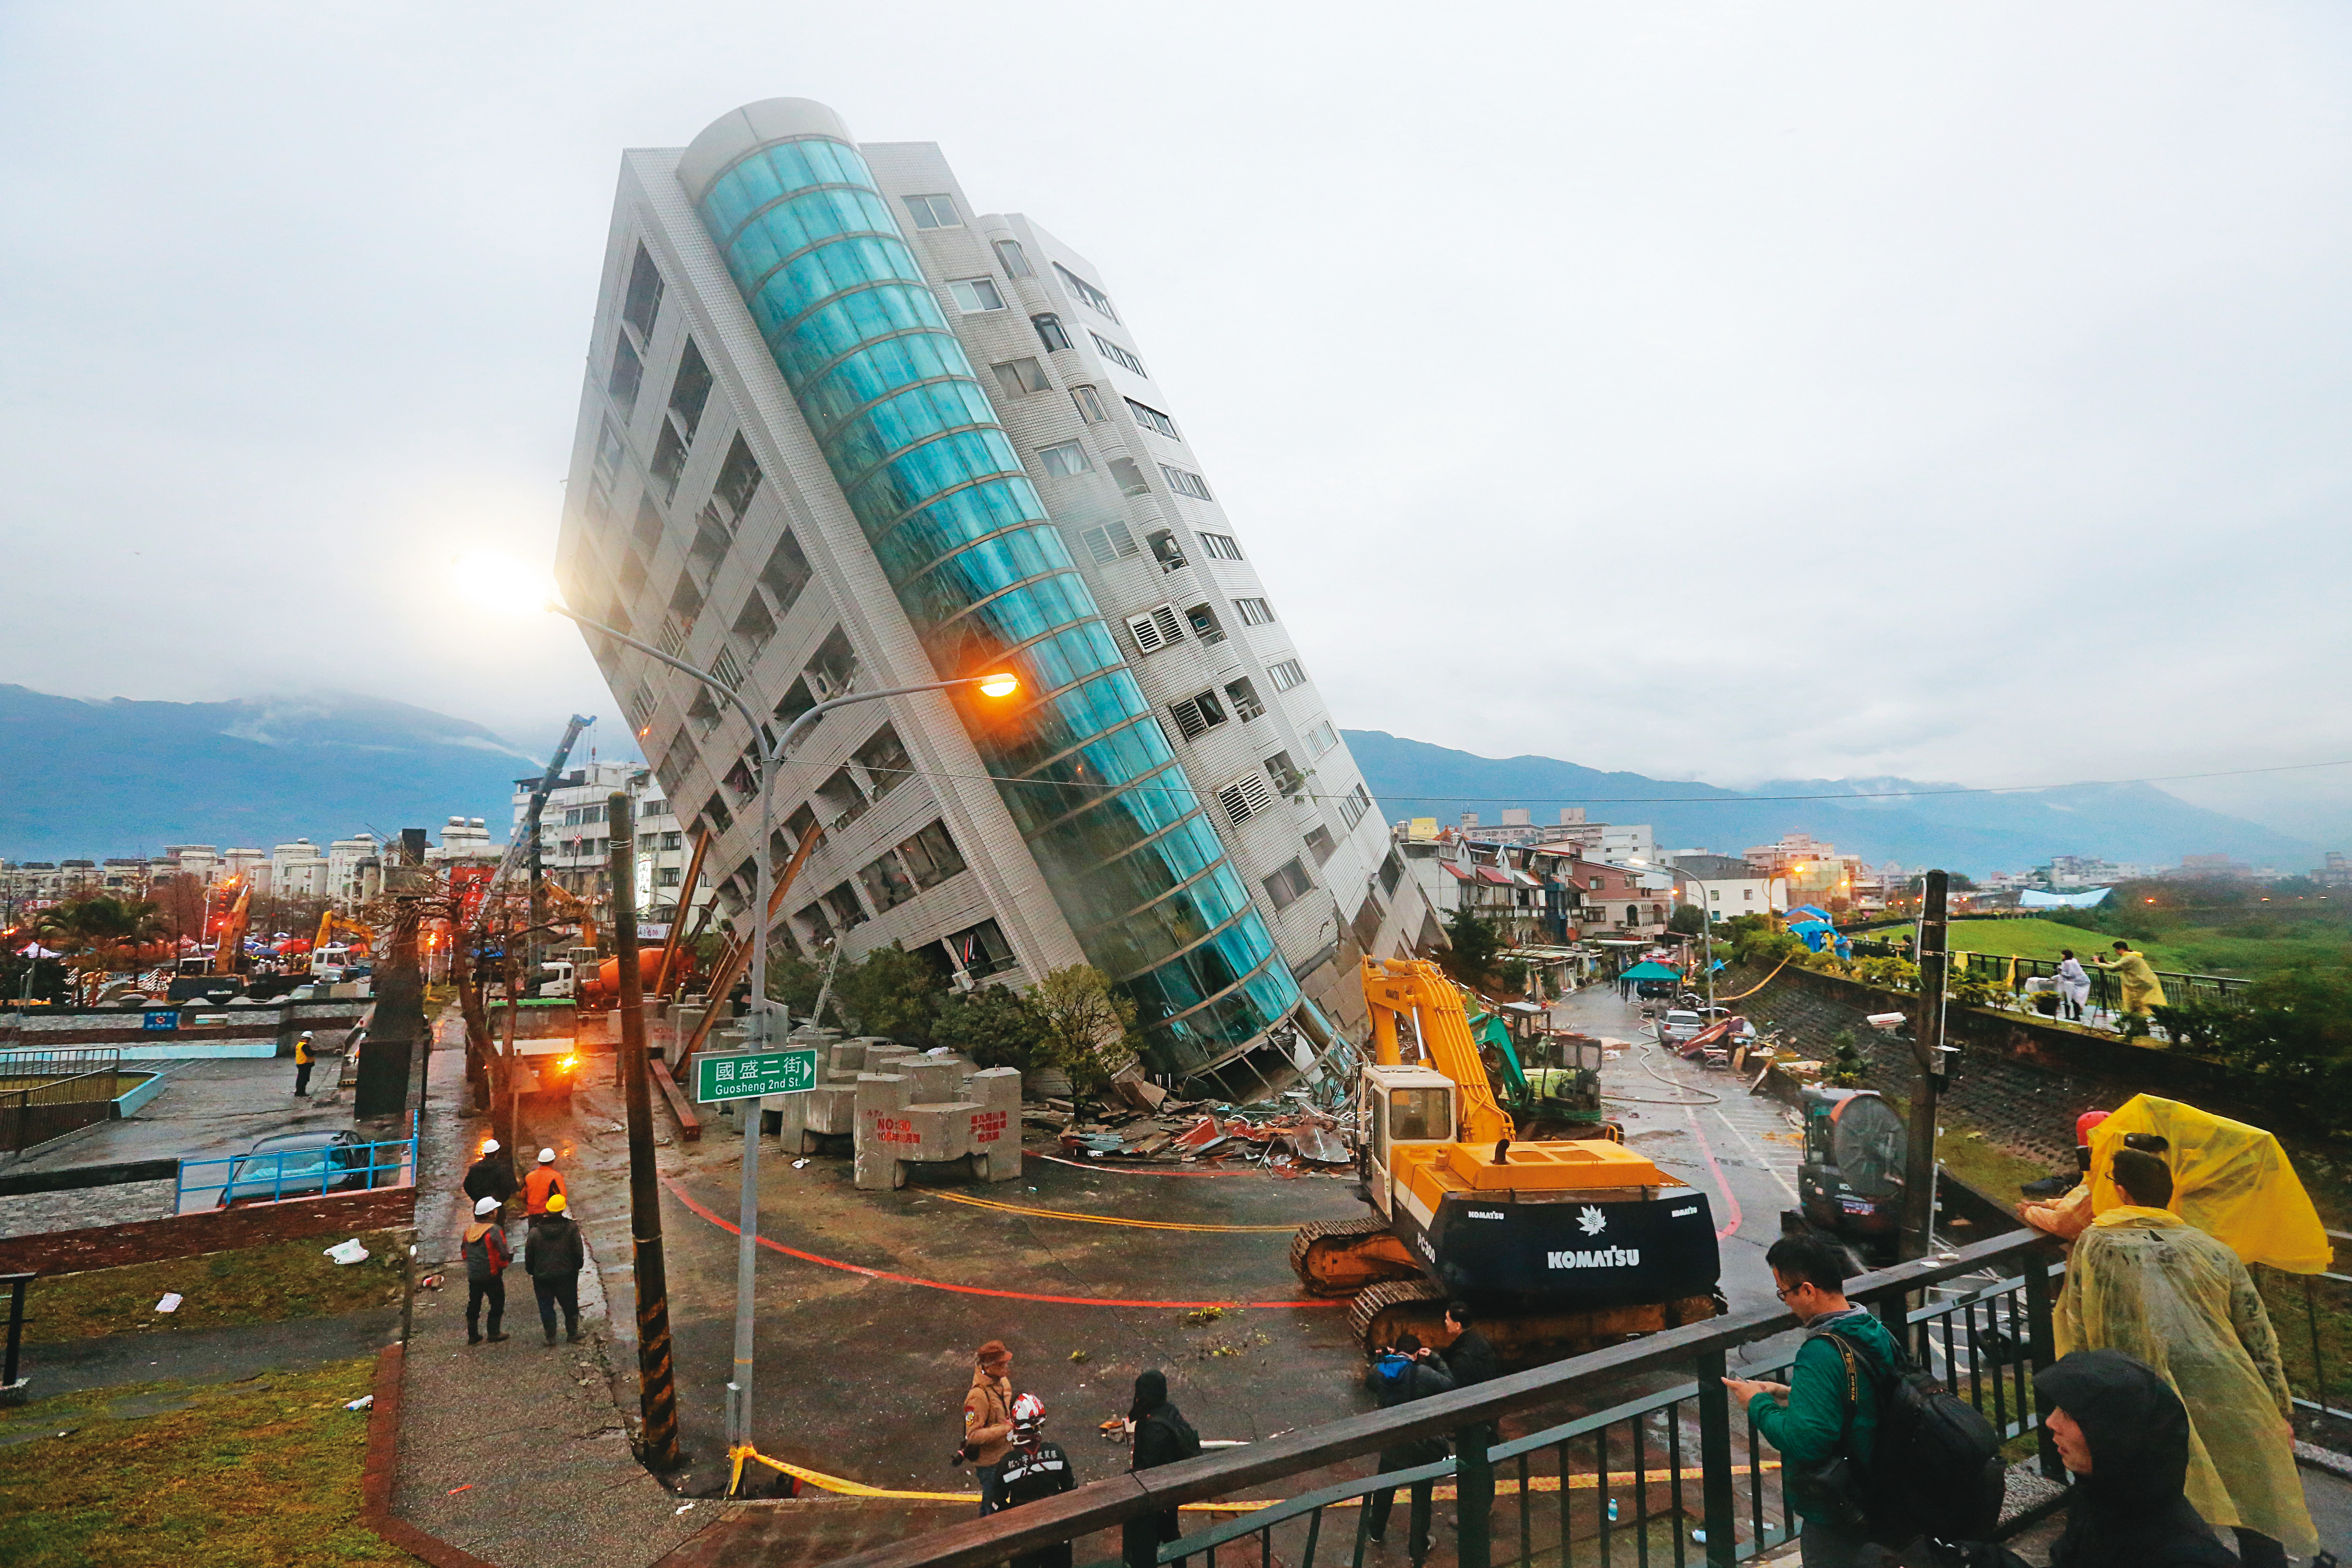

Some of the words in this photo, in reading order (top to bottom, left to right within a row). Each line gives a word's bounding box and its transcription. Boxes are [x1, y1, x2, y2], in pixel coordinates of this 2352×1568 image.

[716, 1057, 801, 1081] 國盛二街
[715, 1082, 766, 1096] Guosheng
[768, 1078, 786, 1090] 2nd
[788, 1077, 801, 1087] St.
[1468, 1211, 1504, 1220] KOMATSU
[1671, 1206, 1697, 1217] KOMATSU
[1417, 1232, 1435, 1263] PC300
[1547, 1245, 1639, 1269] KOMATSU
